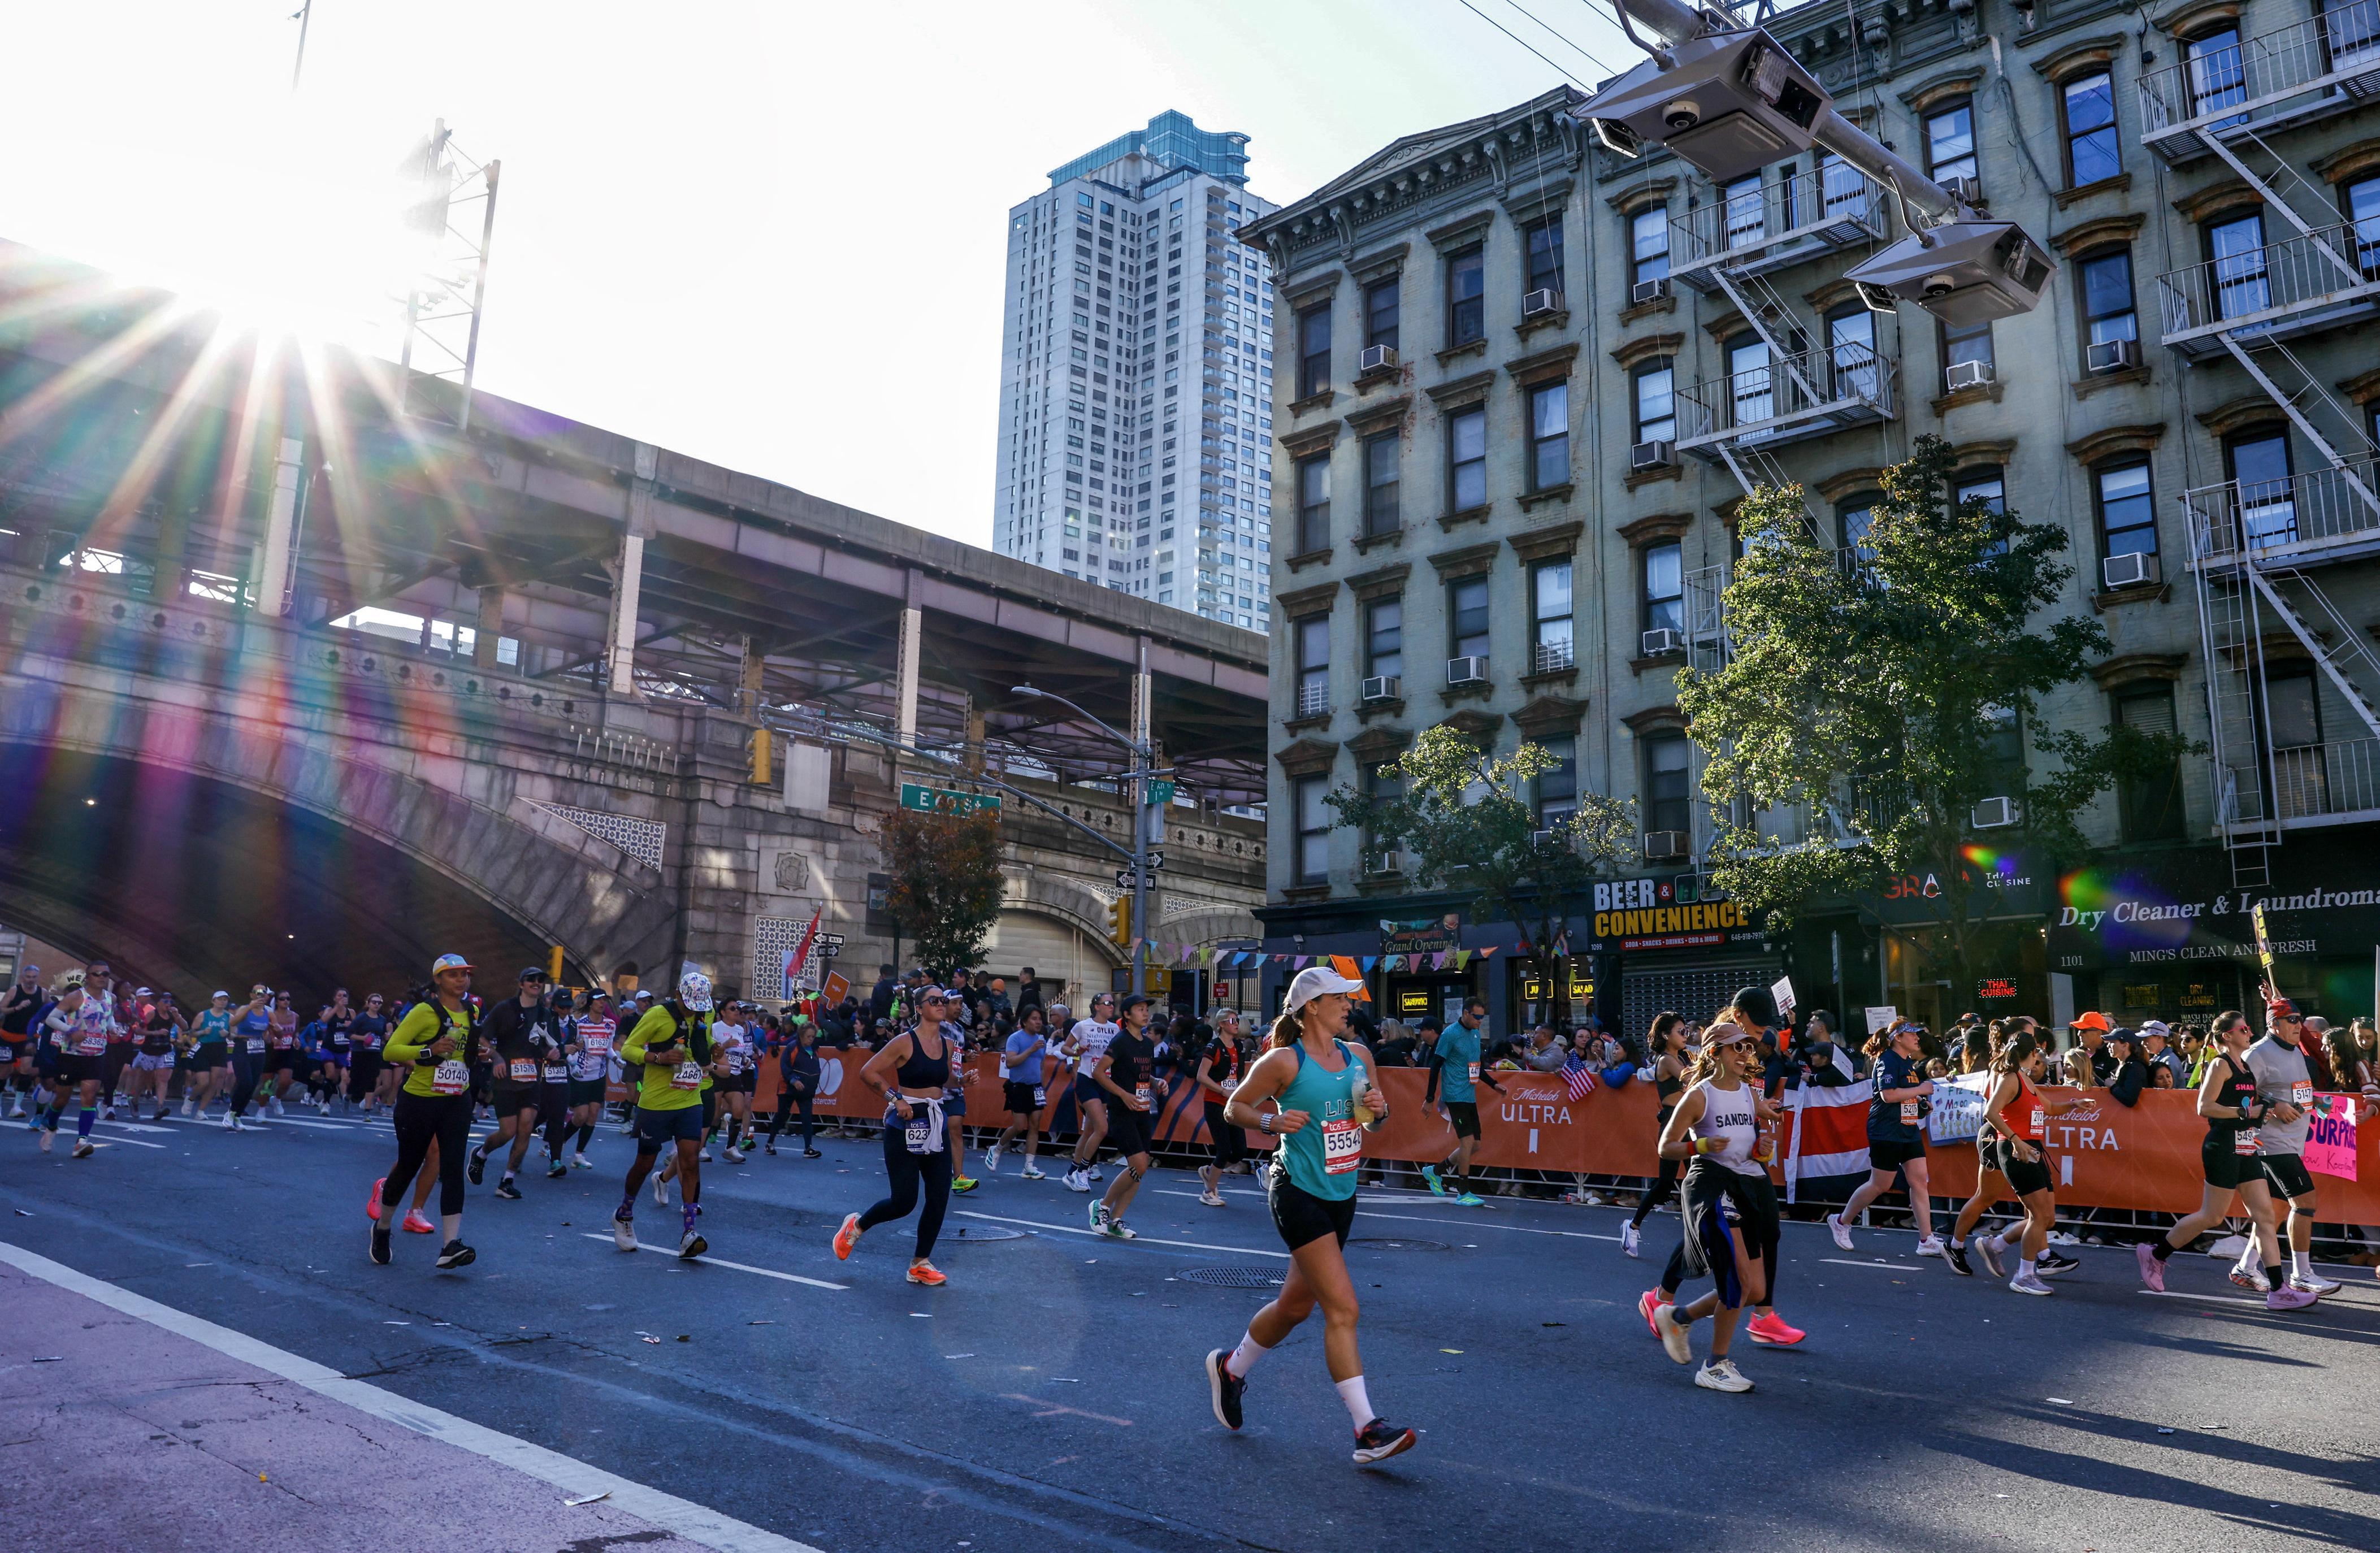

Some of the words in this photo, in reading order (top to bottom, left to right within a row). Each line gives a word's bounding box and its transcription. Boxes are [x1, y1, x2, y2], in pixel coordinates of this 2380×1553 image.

[920, 791, 930, 806] E
[1148, 856, 1159, 865] WAY
[1122, 876, 1133, 884] ONE
[1594, 879, 1655, 911] BEER
[1661, 886, 1670, 897] &
[1595, 902, 1749, 937] CONVENIENCE
[2059, 906, 2106, 931] Dry
[2113, 901, 2205, 923] Cleaner
[2212, 895, 2229, 914] &
[1385, 939, 1412, 955] Grand
[1415, 939, 1453, 954] Opening
[2130, 949, 2175, 962] MING'S
[2180, 945, 2227, 959] CLEAN
[2270, 940, 2317, 954] FRESH
[2061, 956, 2083, 966] 1101
[1986, 980, 2008, 988] THAI
[2190, 984, 2203, 994] DRY
[1981, 987, 2015, 996] CUISINE
[2180, 995, 2214, 1006] CLEANING
[2181, 1014, 2201, 1023] WASH
[437, 1069, 467, 1082] 50140
[514, 1064, 535, 1073] 51578
[1512, 1087, 1561, 1101] Michelob
[1325, 1099, 1354, 1117] LIS
[1501, 1103, 1572, 1125] ULTRA
[1329, 1123, 1341, 1131] tcs
[1715, 1113, 1753, 1128] SANDRA
[1328, 1127, 1361, 1151] 55548
[2045, 1126, 2119, 1151] LTRA
